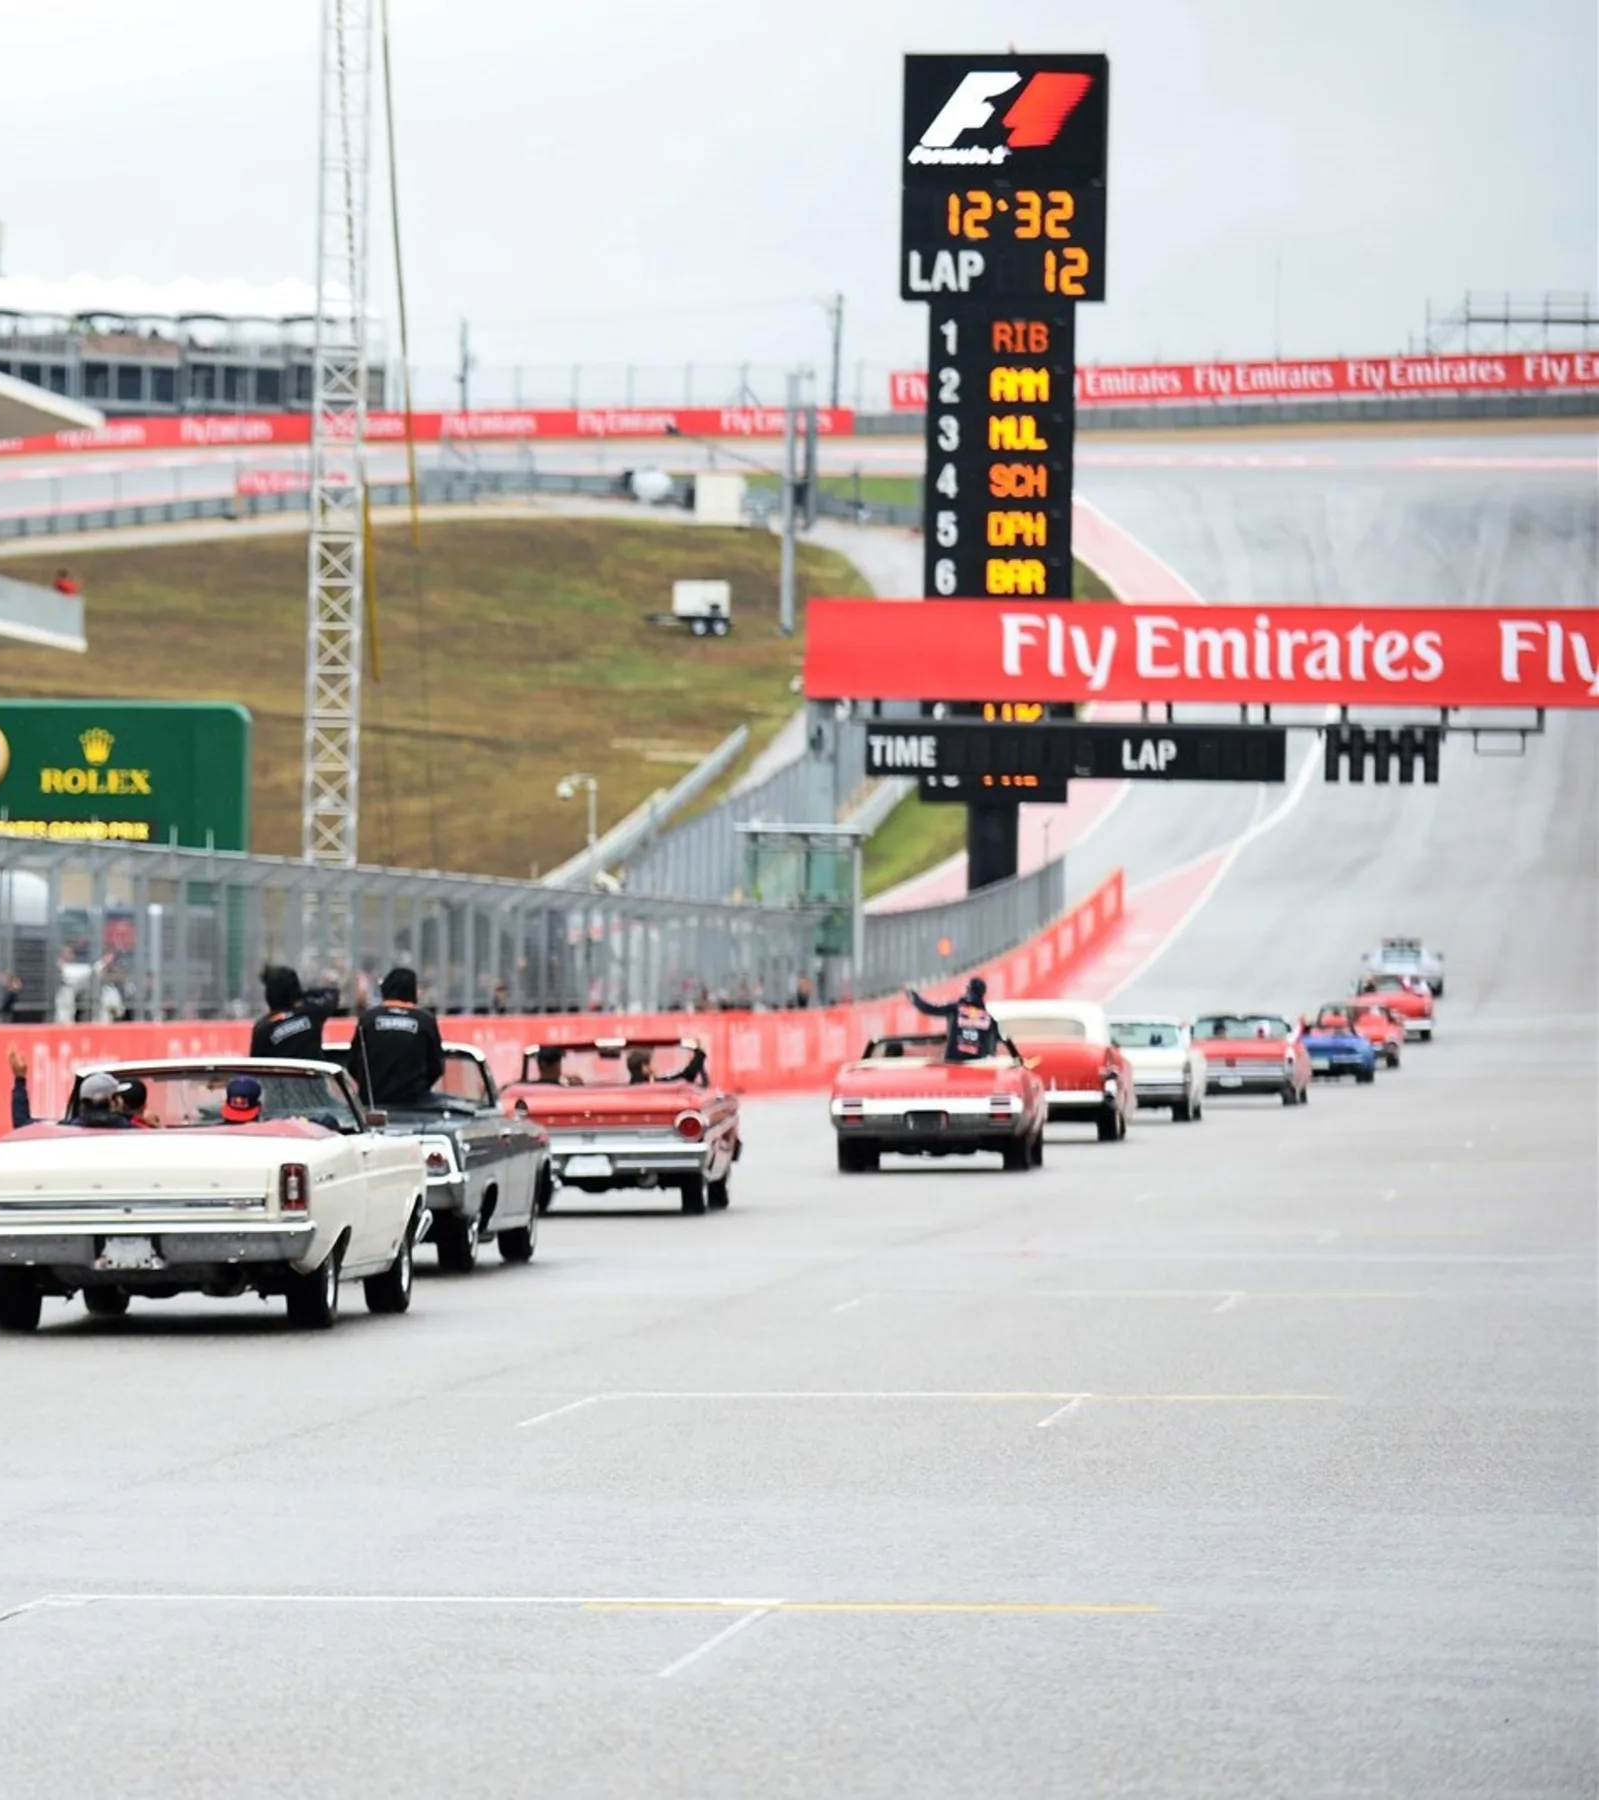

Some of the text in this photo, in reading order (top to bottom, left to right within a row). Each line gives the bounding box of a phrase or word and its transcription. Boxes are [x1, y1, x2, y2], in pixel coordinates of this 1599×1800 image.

[909, 247, 1089, 295] LAP 12
[940, 319, 1049, 356] 1 RIB
[938, 367, 960, 404] 2
[990, 366, 1049, 402] AMM
[1194, 363, 1334, 394] Fly Emirates
[1347, 357, 1506, 390] Fly Emirates
[1524, 354, 1570, 384] Fly
[937, 414, 1048, 452] 3 MUL
[936, 462, 1048, 499] 4 SCH
[936, 510, 958, 548] 5
[935, 558, 1046, 596] 6 BAR
[1001, 613, 1444, 691] Fly Emirates
[869, 736, 1178, 771] TIME LAP
[40, 768, 152, 794] ROLEX
